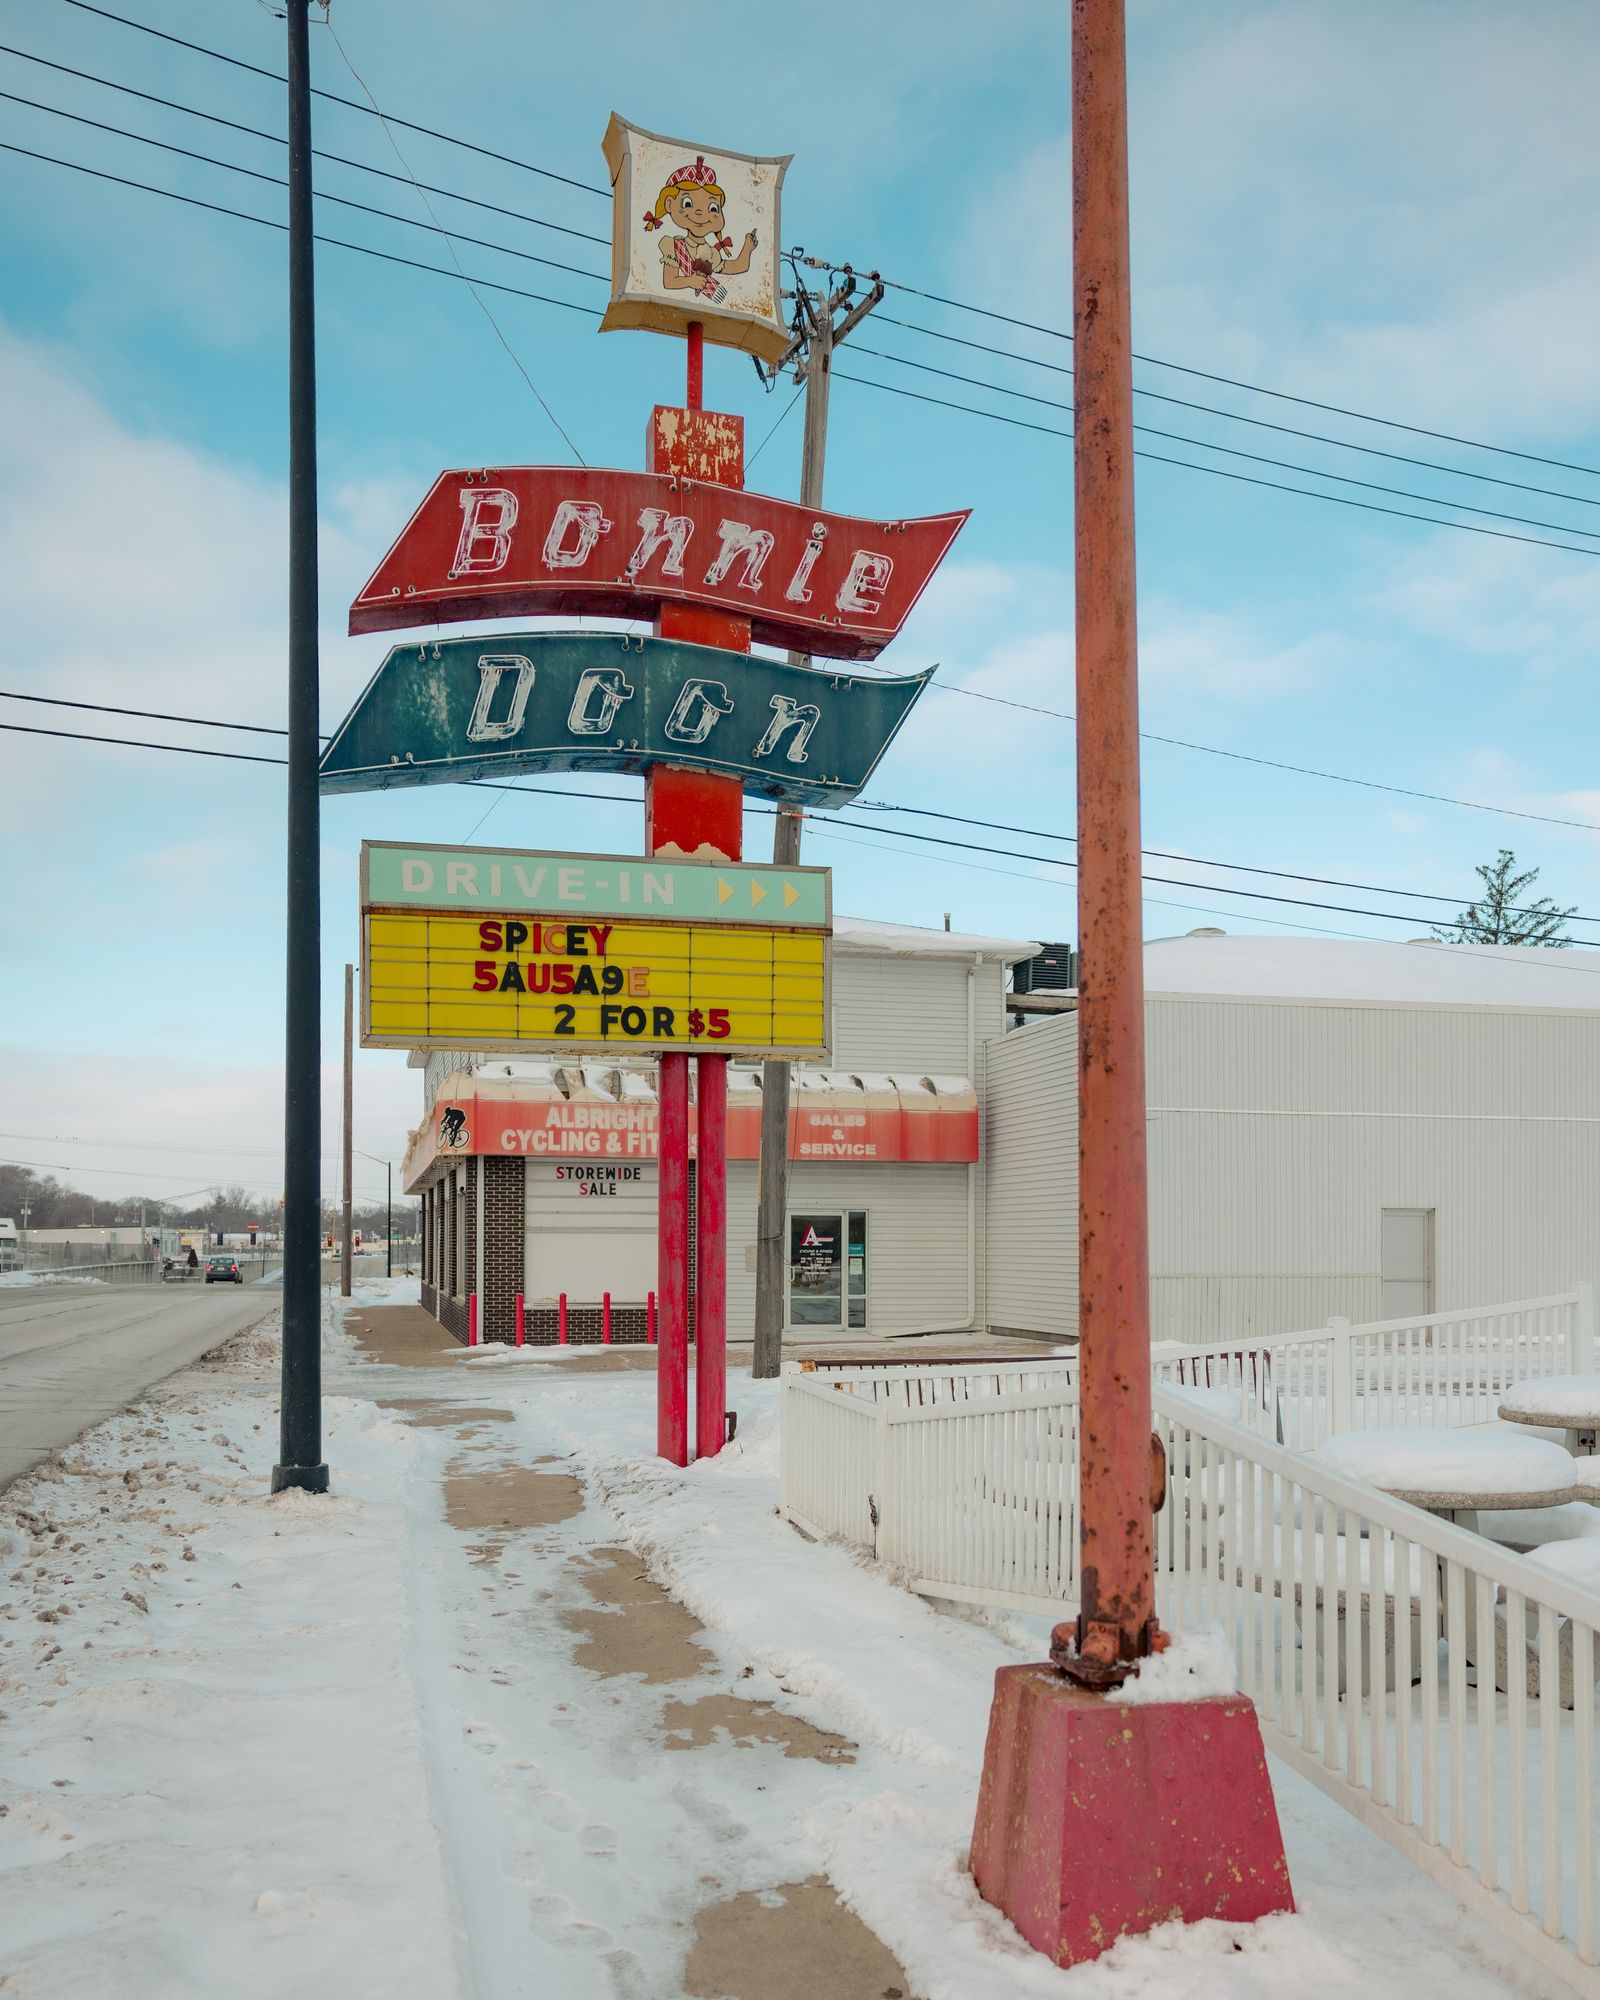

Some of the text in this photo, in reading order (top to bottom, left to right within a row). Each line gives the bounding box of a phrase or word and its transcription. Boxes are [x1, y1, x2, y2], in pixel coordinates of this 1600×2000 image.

[447, 487, 894, 615] Bonnie
[402, 859, 675, 905] DRIVE-IN
[478, 920, 613, 956] SPICEY
[554, 1003, 731, 1038] 2 FOR $5
[545, 1106, 659, 1129] ALBRIGHT
[808, 1113, 866, 1127] SALES
[501, 1128, 600, 1152] CYCLING
[605, 1131, 622, 1153] &
[831, 1128, 845, 1140] &
[799, 1142, 877, 1156] SERVICE
[556, 1166, 641, 1180] STOREWIDE
[579, 1182, 617, 1196] SALE
